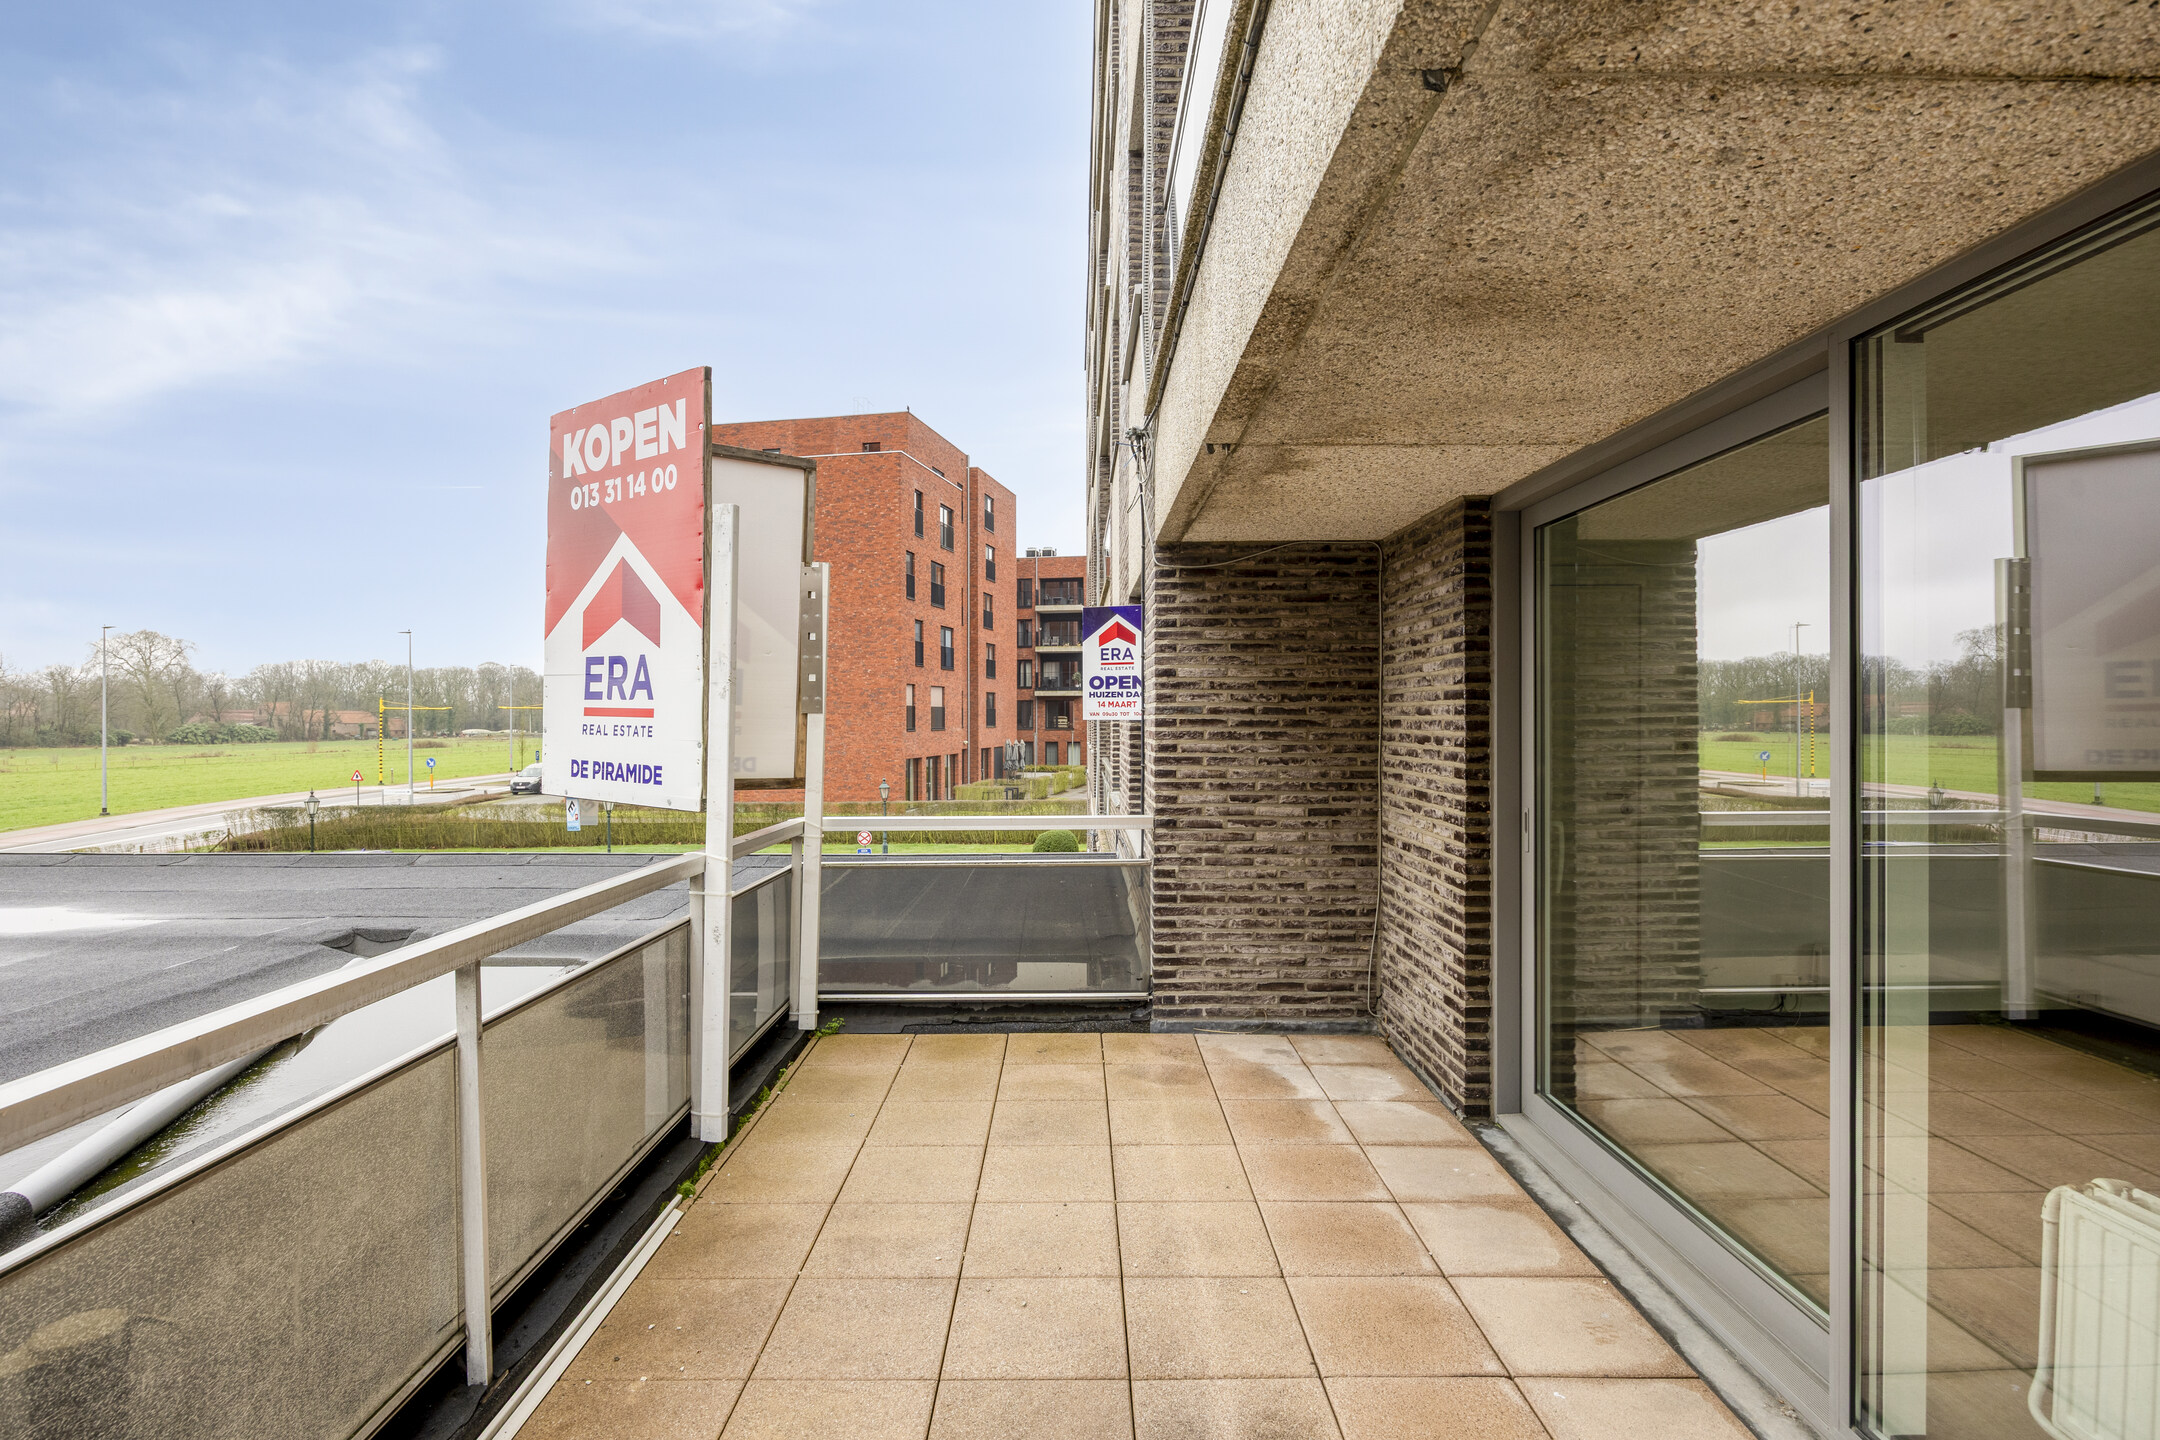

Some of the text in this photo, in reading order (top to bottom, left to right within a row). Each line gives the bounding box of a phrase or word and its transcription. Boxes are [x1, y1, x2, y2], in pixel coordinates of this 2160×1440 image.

[563, 398, 686, 479] KOPEN
[570, 463, 678, 511] 013 31 14 00
[1100, 647, 1134, 661] ERA
[583, 654, 654, 701] ERA
[1089, 675, 1142, 690] OPEN
[582, 723, 653, 738] REAL ESTATE
[570, 759, 663, 786] DE PIRAMIDE
